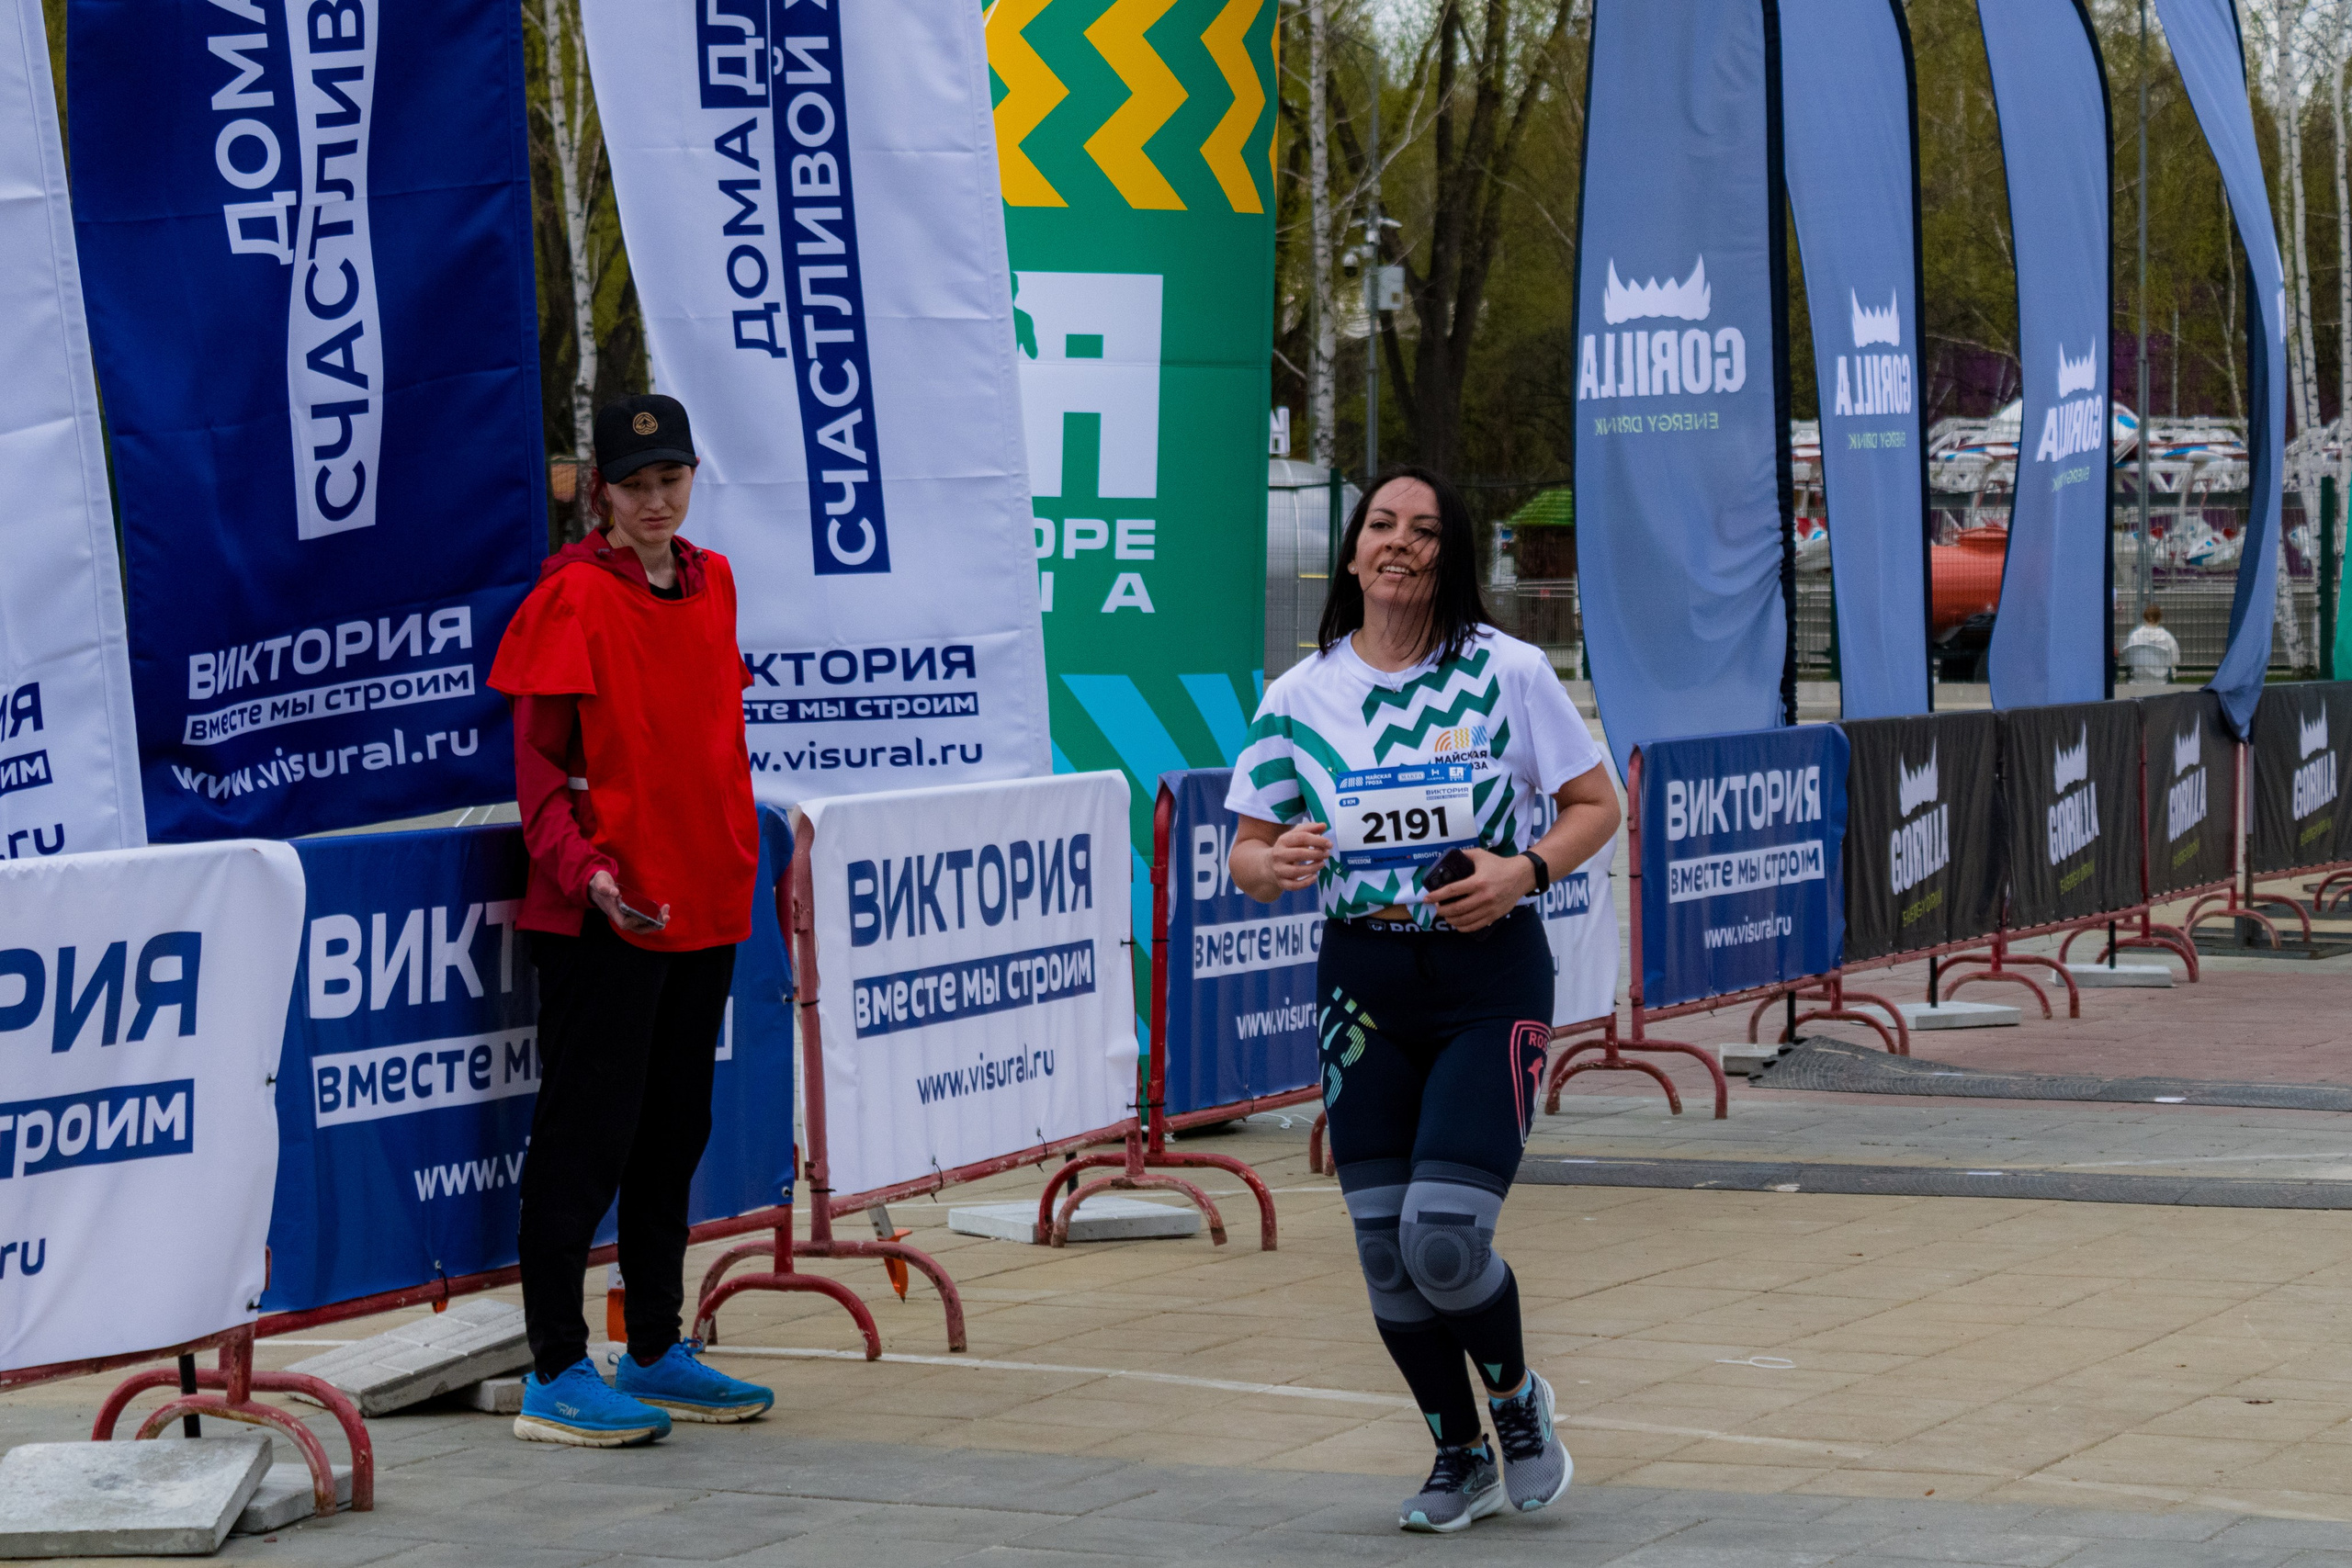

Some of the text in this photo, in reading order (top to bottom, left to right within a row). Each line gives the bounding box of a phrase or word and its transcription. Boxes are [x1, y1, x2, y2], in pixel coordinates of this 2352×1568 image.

[715, 117, 787, 358] ДОМА
[774, 37, 876, 565] СЧАСТЛИВОЙ
[188, 605, 472, 700] ВИКТОРИЯ
[189, 670, 469, 741] вместе мы строим
[798, 700, 845, 719] мы
[854, 694, 976, 720] строим
[1425, 787, 1469, 796] ВИКТОРИЯ
[1434, 750, 1488, 764] МАЙСКАЯ
[2291, 749, 2338, 821] GORILLA
[1361, 806, 1449, 844] 2191
[1667, 766, 1822, 841] ВИКТОРИЯ
[2047, 782, 2100, 866] GORILLA
[1670, 860, 1734, 896] вместе
[1738, 857, 1760, 885] мы
[1891, 803, 1951, 896] GORILLA
[847, 833, 1093, 948] ВИКТОРИЯ
[1194, 926, 1272, 970] вместе
[1275, 922, 1304, 959] мы
[1704, 911, 1792, 950] www.visural.ru
[854, 948, 1091, 1029] вместе мы строим
[317, 1043, 492, 1114] вместе
[917, 1043, 1056, 1105] www.visural.ru
